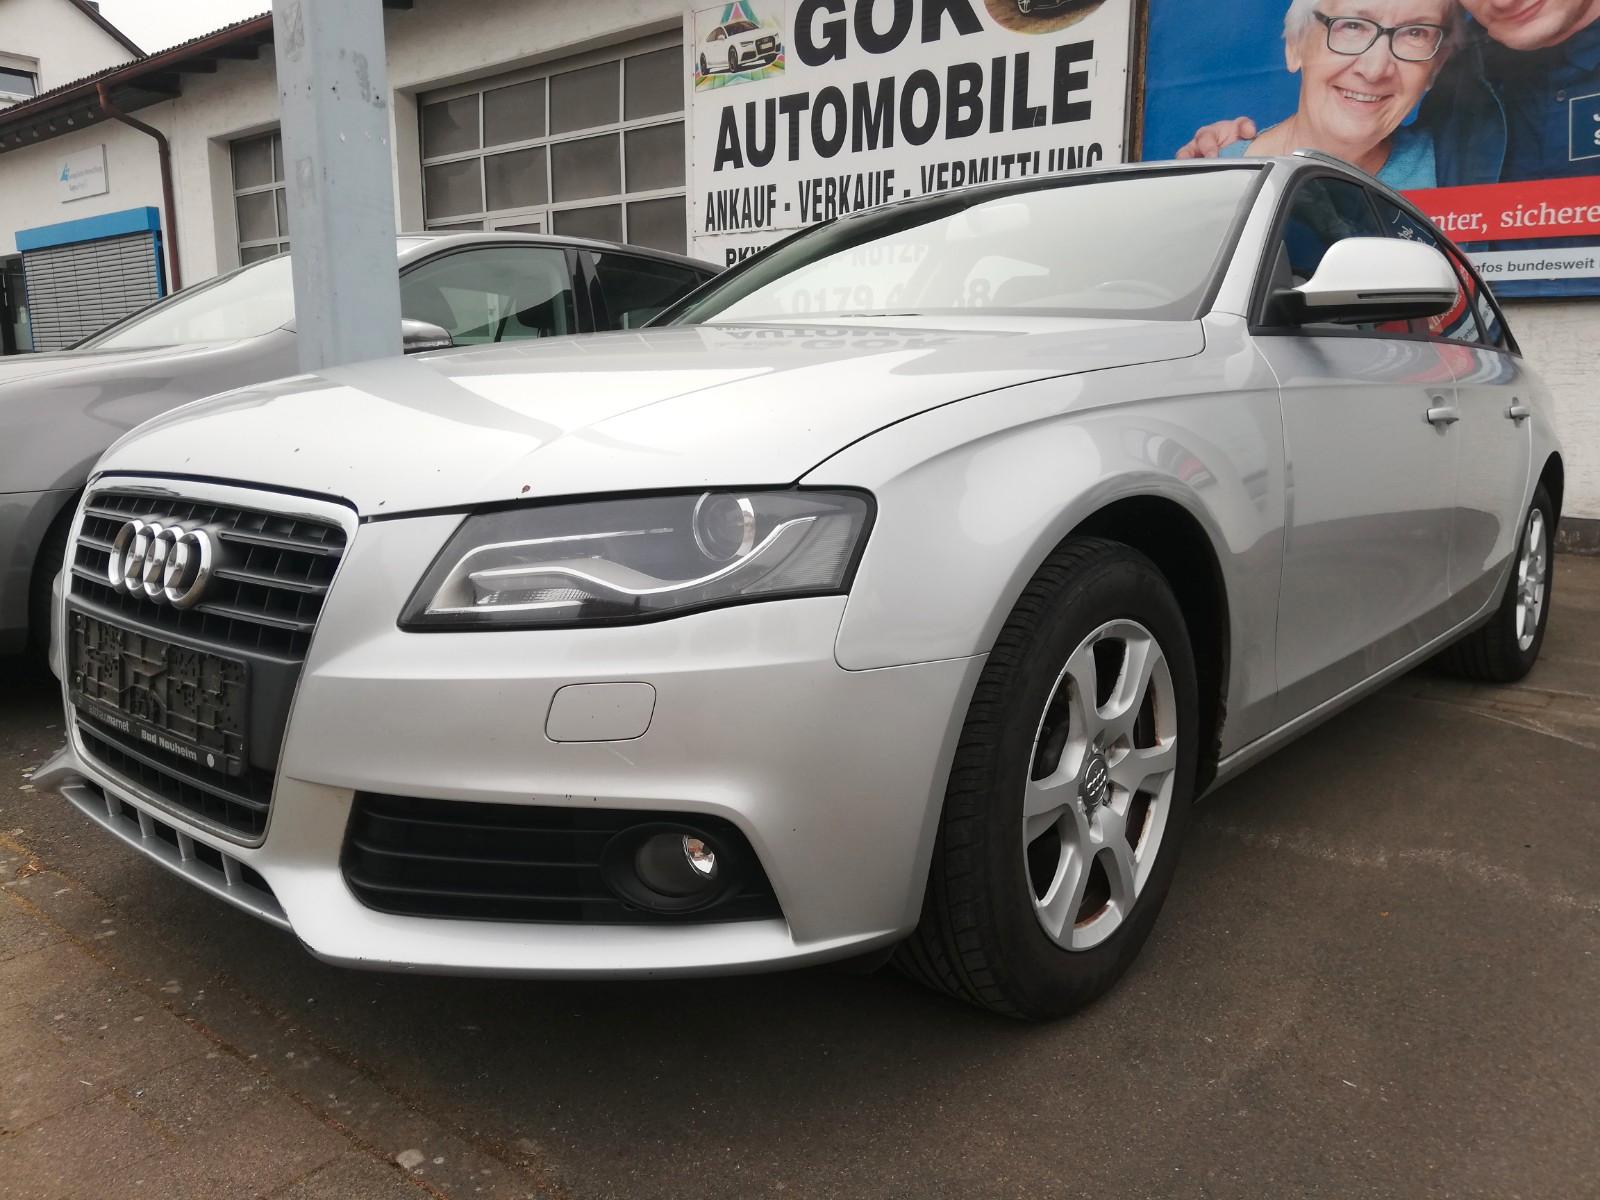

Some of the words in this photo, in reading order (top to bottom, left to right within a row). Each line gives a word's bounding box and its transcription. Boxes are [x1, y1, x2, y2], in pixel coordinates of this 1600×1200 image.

[713, 39, 1095, 172] AUTOMOBILE
[705, 183, 777, 232] ANKAUF
[798, 169, 895, 223] VERKAUF
[1500, 202, 1600, 228] sichere
[1507, 257, 1595, 272] bundesweit
[141, 729, 157, 744] Bad
[159, 737, 197, 761] Nauheim
